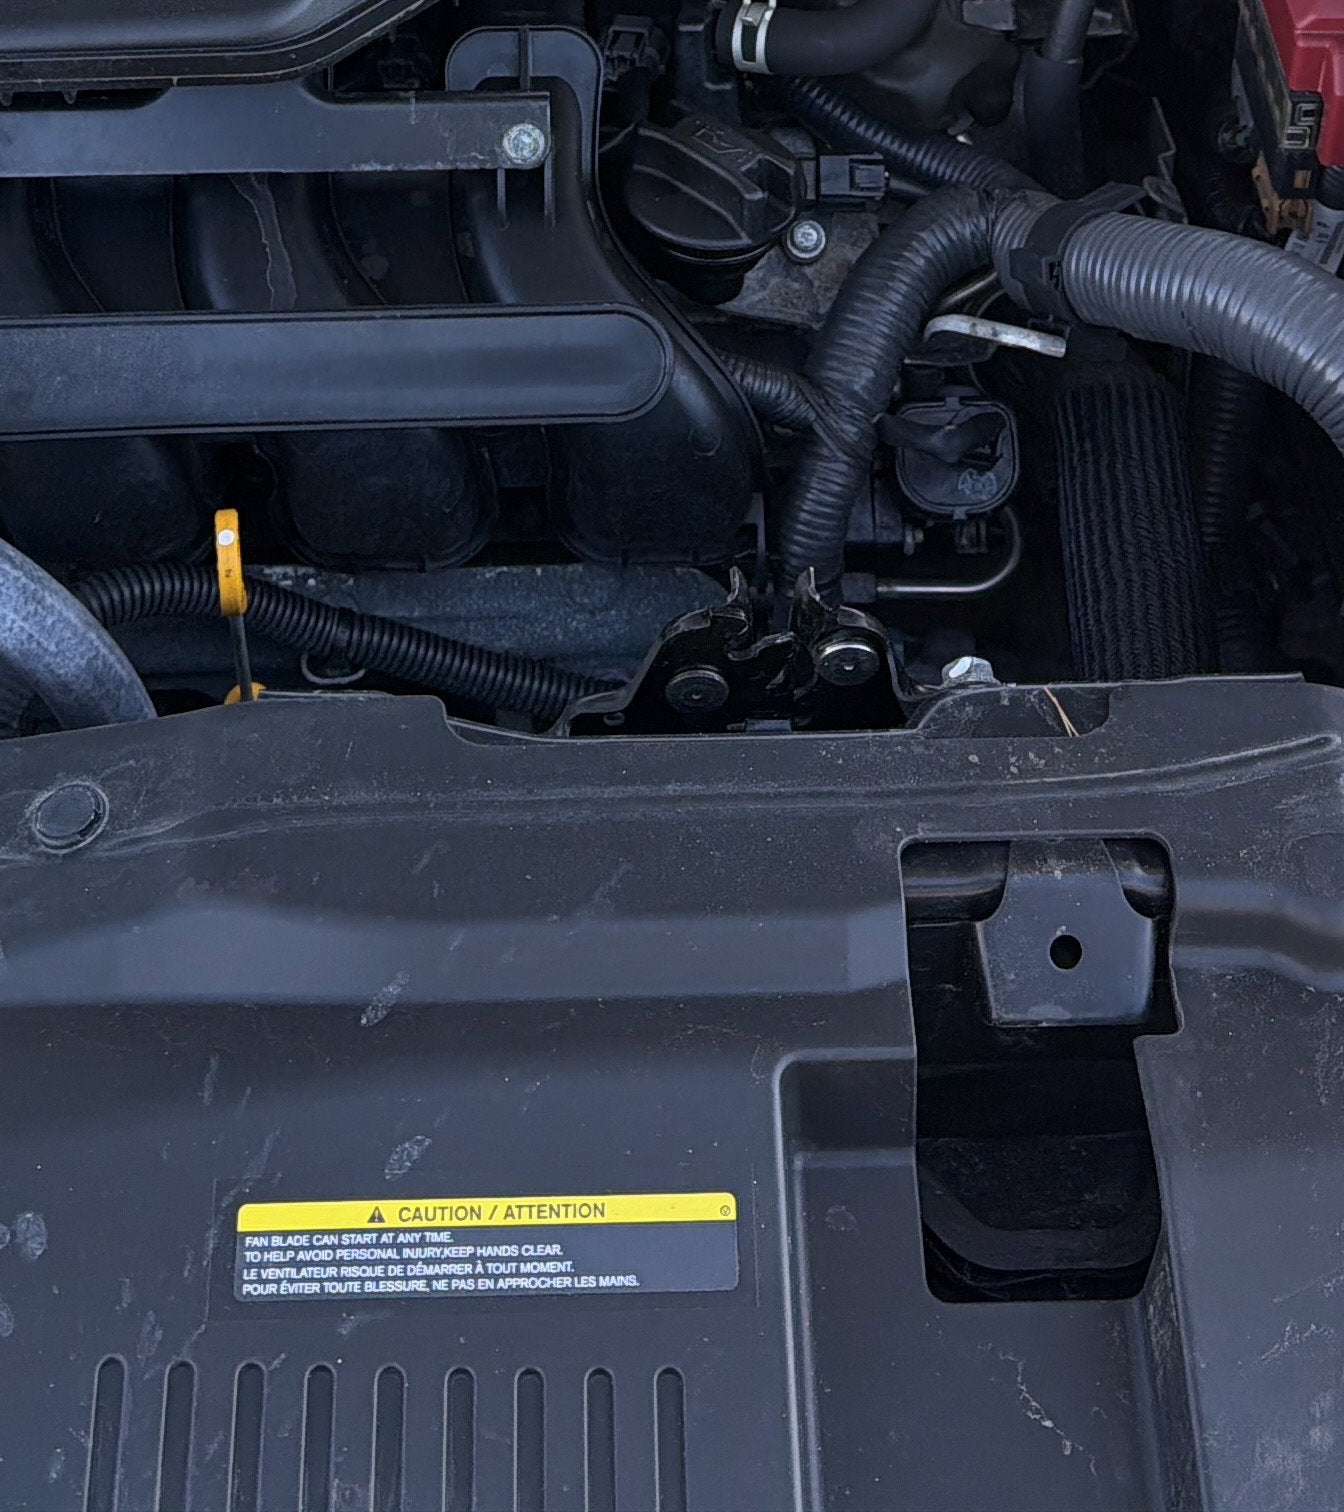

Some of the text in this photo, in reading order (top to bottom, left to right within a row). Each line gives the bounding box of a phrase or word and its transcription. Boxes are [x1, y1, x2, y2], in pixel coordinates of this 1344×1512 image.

[397, 1201, 607, 1223] CAUTION / ATTENTION
[244, 1231, 455, 1248] FAN BLADE CAN START AT ANY TIME.
[244, 1250, 262, 1263] TO
[263, 1249, 295, 1262] HELP
[296, 1249, 334, 1262] AVOID
[335, 1248, 400, 1261] PERSONAL
[476, 1245, 519, 1257] HANDS
[520, 1243, 564, 1257] CLEAR.
[242, 1259, 575, 1281] LE VENTILATEUR RISQUE DE DÉMARRER À TOUT MOMENT.
[242, 1274, 641, 1296] POUR ÉVITER TOUTE BLESSURE, NE PAS EN APPROCHER LES MAINS.
